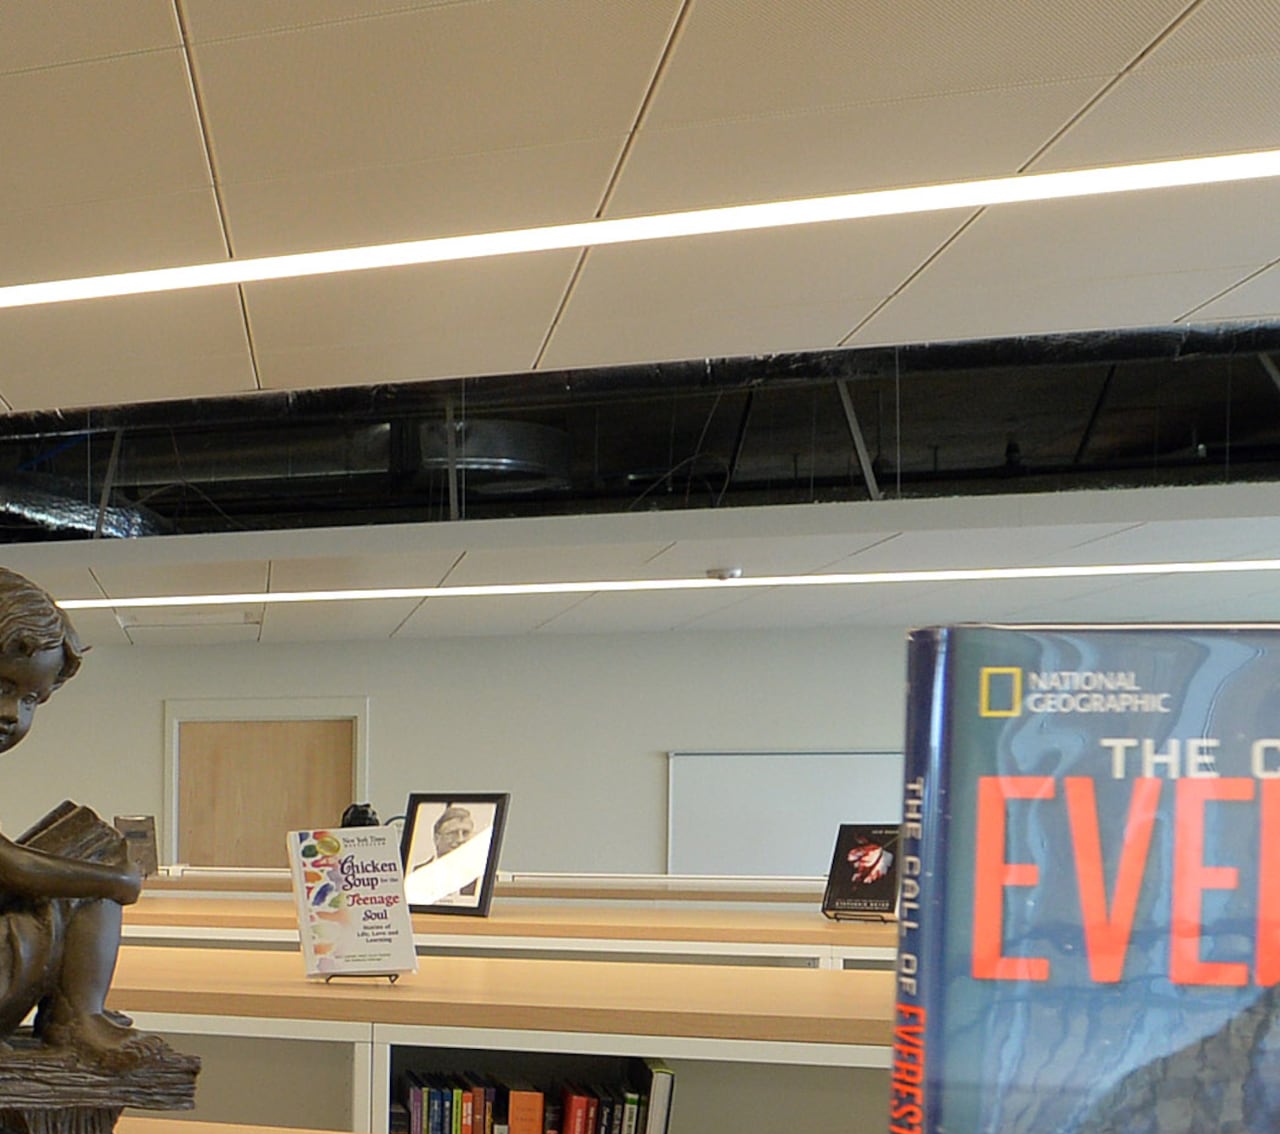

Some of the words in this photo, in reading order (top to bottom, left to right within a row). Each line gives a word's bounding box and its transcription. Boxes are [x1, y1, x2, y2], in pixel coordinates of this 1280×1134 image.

[1028, 671, 1141, 691] NATIONAL
[1026, 692, 1171, 713] GEOGRAPHIC
[1099, 738, 1221, 779] THE
[903, 777, 924, 840] THE
[339, 855, 397, 875] Chicken
[342, 873, 379, 891] Soup
[346, 893, 400, 907] Teenage
[901, 855, 921, 937] CALL
[362, 909, 388, 922] Soul
[899, 953, 918, 996] OF
